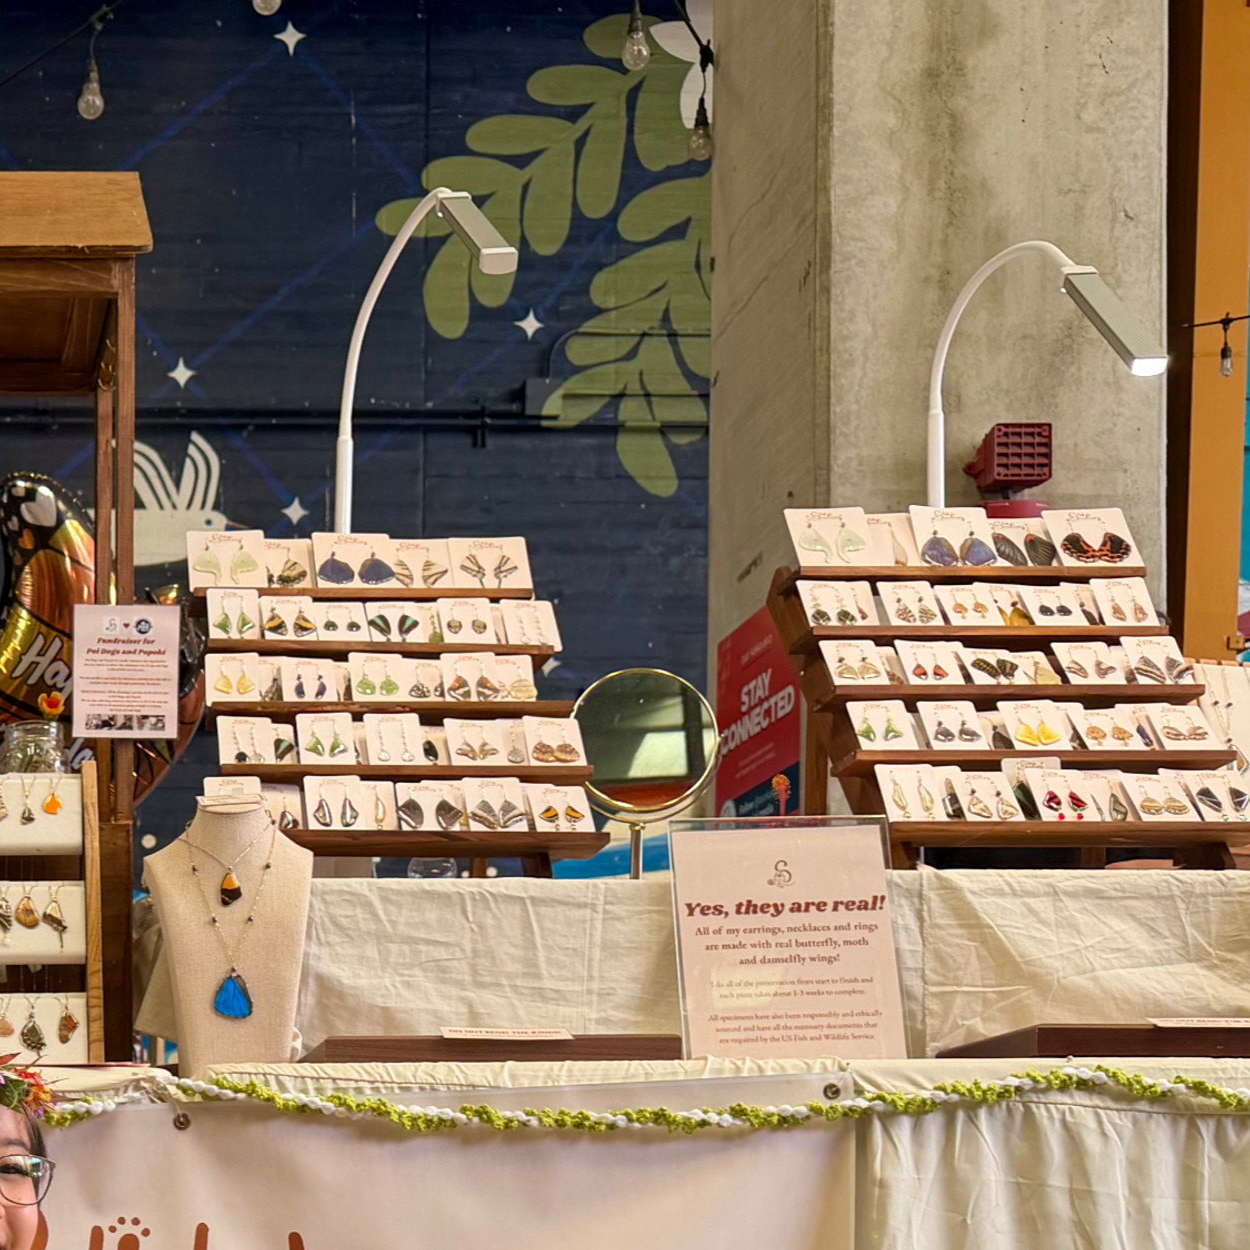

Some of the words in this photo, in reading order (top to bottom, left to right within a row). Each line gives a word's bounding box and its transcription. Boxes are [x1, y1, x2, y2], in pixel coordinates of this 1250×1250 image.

[101, 648, 120, 656] Dogs
[741, 668, 772, 713] STAY
[719, 685, 795, 755] CONNECTED
[684, 902, 729, 918] Yes,
[735, 899, 785, 918] they
[789, 900, 827, 913] are
[832, 895, 886, 912] real!
[695, 926, 709, 936] All
[713, 925, 724, 935] of
[726, 927, 740, 937] my
[743, 925, 785, 935] earrings,
[787, 923, 831, 933] necklaces
[833, 922, 851, 932] and
[854, 922, 879, 933] rings
[705, 943, 719, 951] are
[722, 941, 748, 950] made
[750, 940, 772, 949] with
[775, 939, 793, 949] real
[795, 938, 841, 949] butterfly,
[843, 937, 869, 946] moth
[739, 955, 757, 965] and
[760, 954, 805, 965] damselfly
[808, 953, 840, 965] wings!
[744, 979, 754, 987] the
[797, 977, 813, 986] from
[772, 989, 791, 997] about
[708, 1014, 719, 1022] All
[755, 1013, 770, 1021] have
[841, 1010, 854, 1018] and
[743, 1024, 755, 1032] and
[773, 1023, 781, 1031] all
[782, 1023, 792, 1031] the
[864, 1021, 878, 1029] that
[760, 1035, 768, 1044] by
[770, 1035, 780, 1043] the
[794, 1034, 808, 1042] Fish
[823, 1033, 849, 1041] Wildlife
